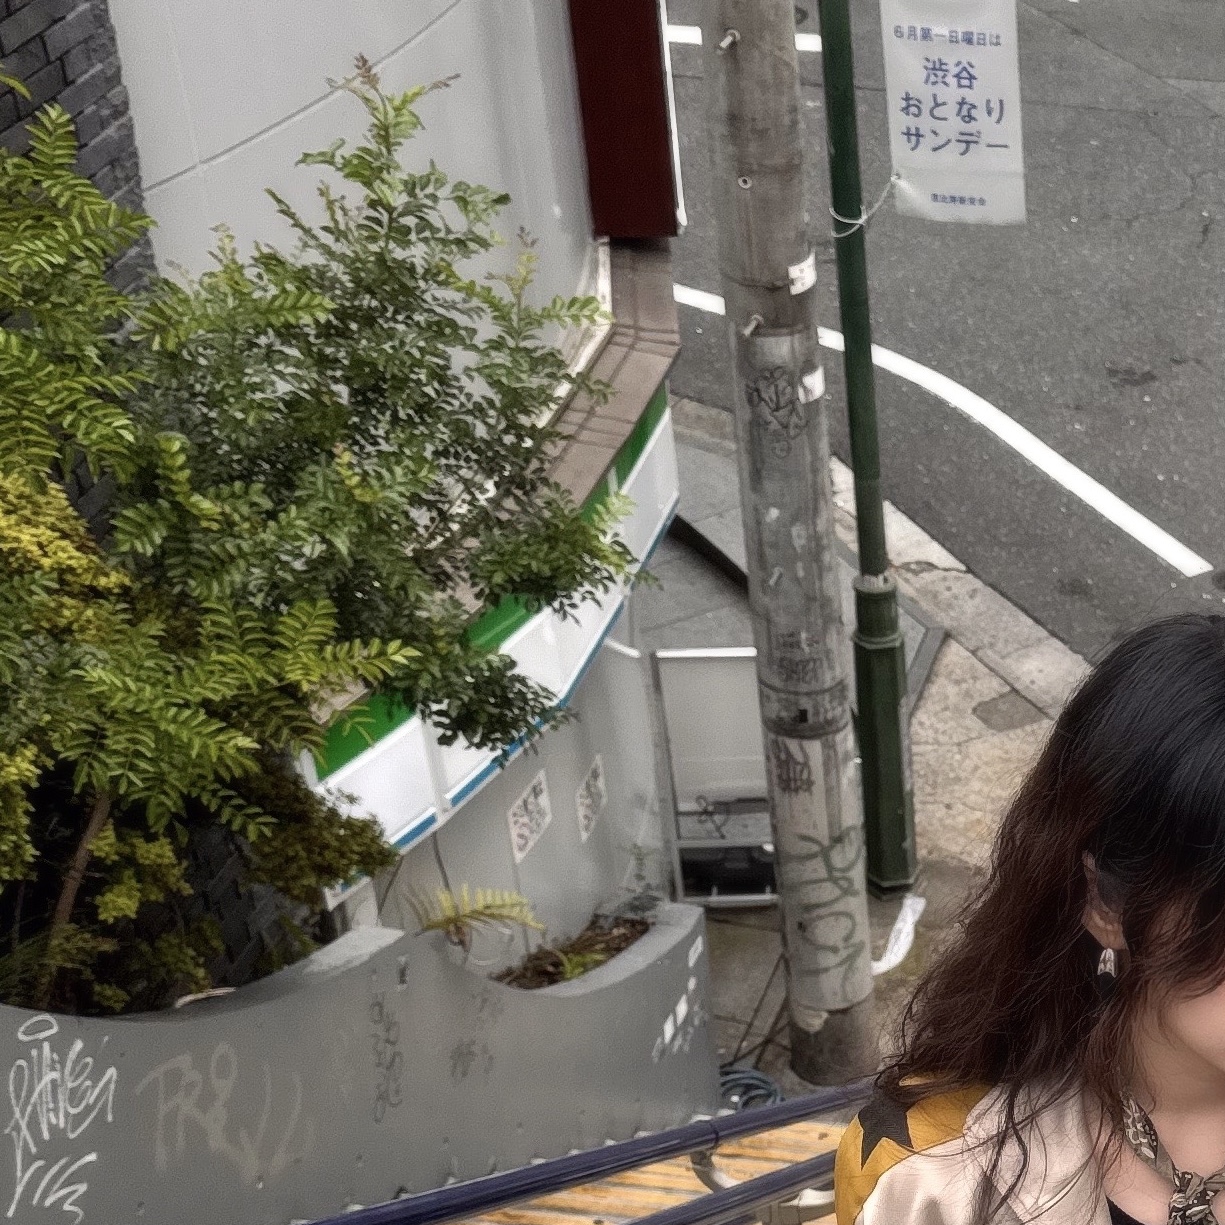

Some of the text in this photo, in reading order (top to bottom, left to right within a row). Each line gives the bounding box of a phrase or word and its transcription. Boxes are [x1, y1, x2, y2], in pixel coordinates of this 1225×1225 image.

[893, 25, 1002, 46] 6月第一日曜日は
[923, 57, 978, 89] 渋谷
[900, 91, 1005, 124] おとなり
[901, 126, 1009, 156] サンデー
